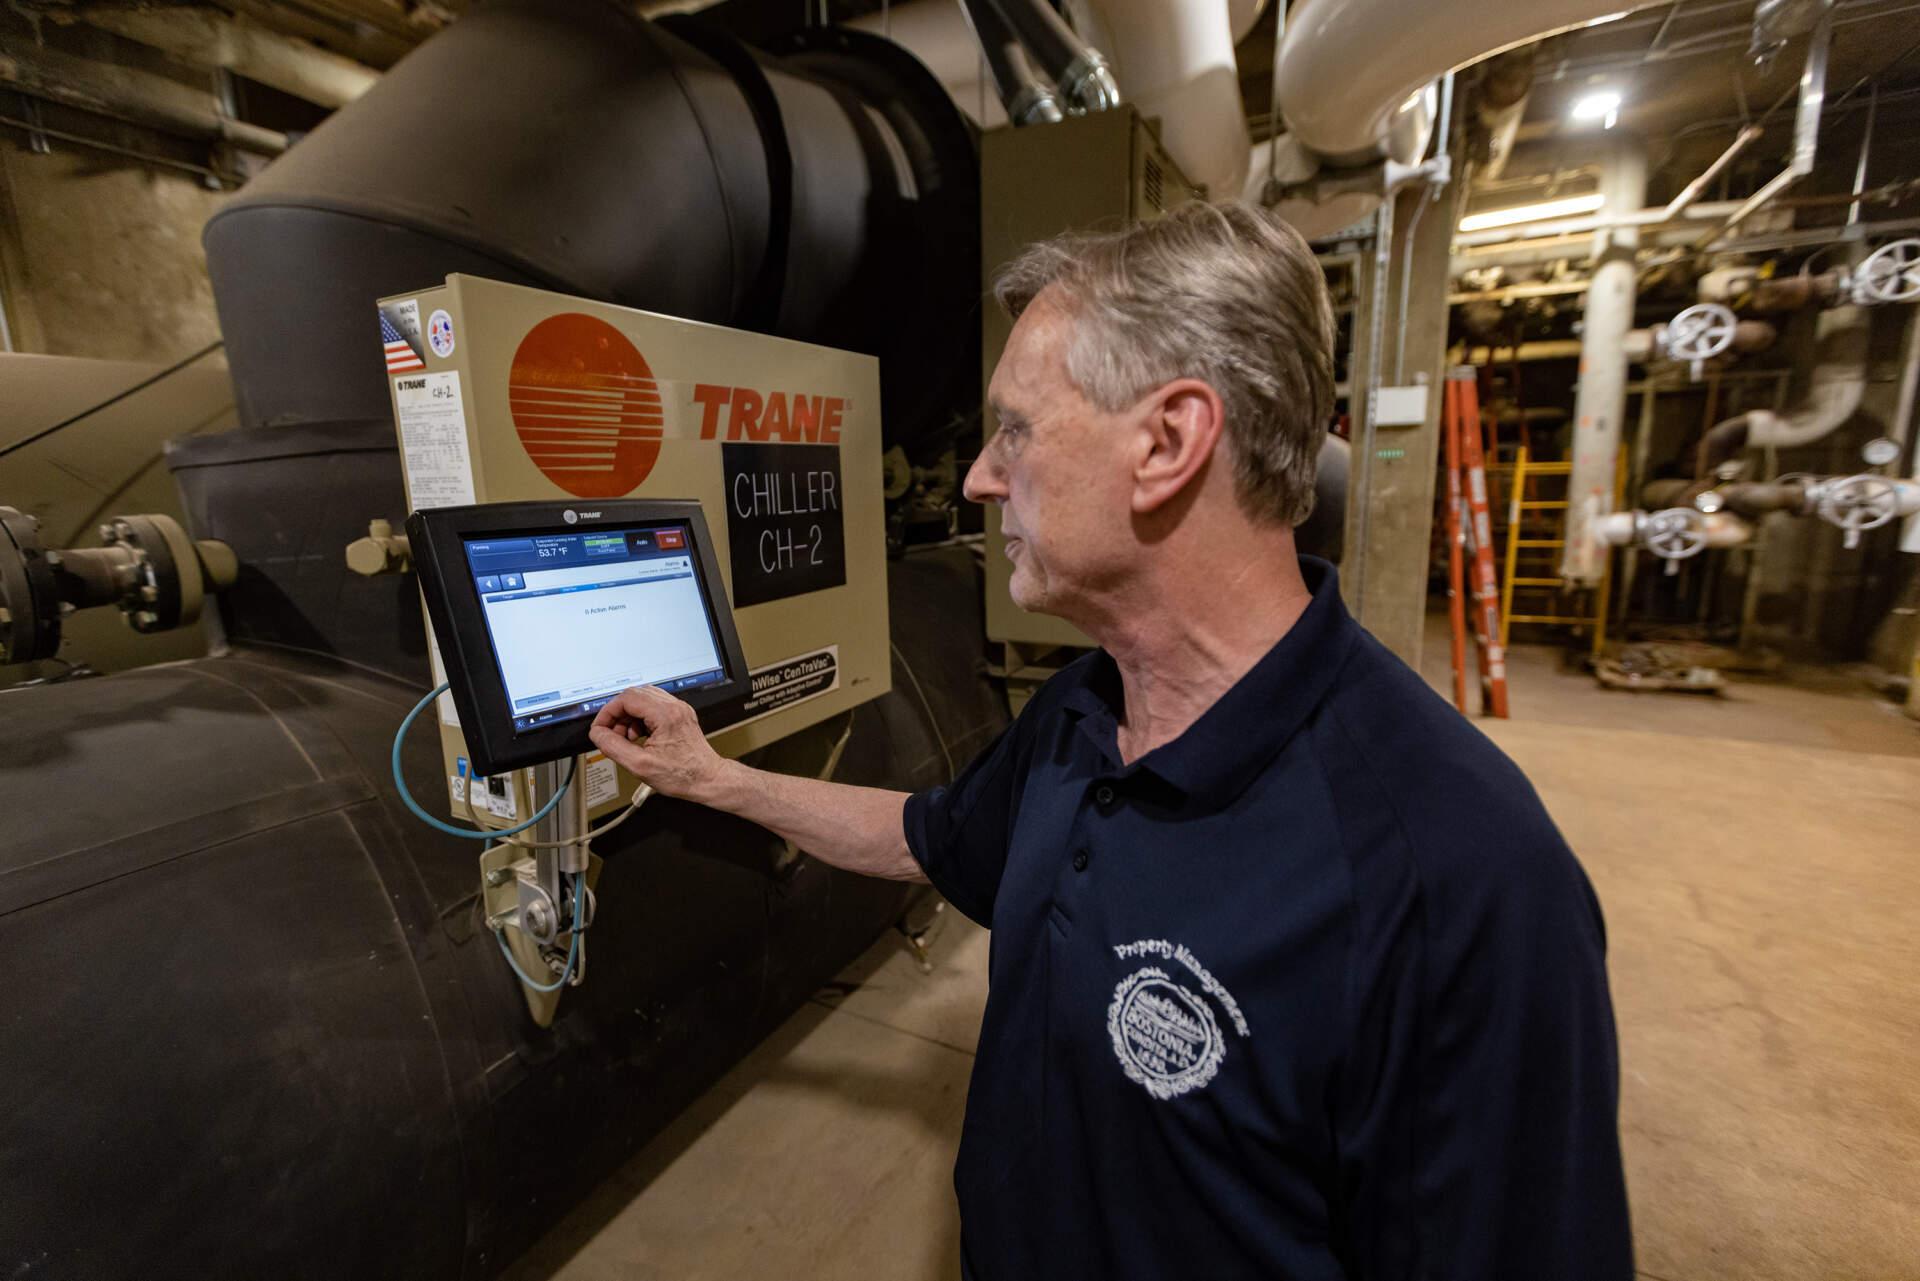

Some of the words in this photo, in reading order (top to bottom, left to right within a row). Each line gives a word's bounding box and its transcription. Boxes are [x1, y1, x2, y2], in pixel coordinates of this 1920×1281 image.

[404, 379, 427, 391] TRANE
[693, 383, 845, 444] TRANE
[733, 471, 837, 519] CHILLER
[538, 548, 556, 558] 53.7
[558, 547, 568, 556] °F
[759, 524, 824, 574] CH-2
[752, 674, 781, 692] hWise
